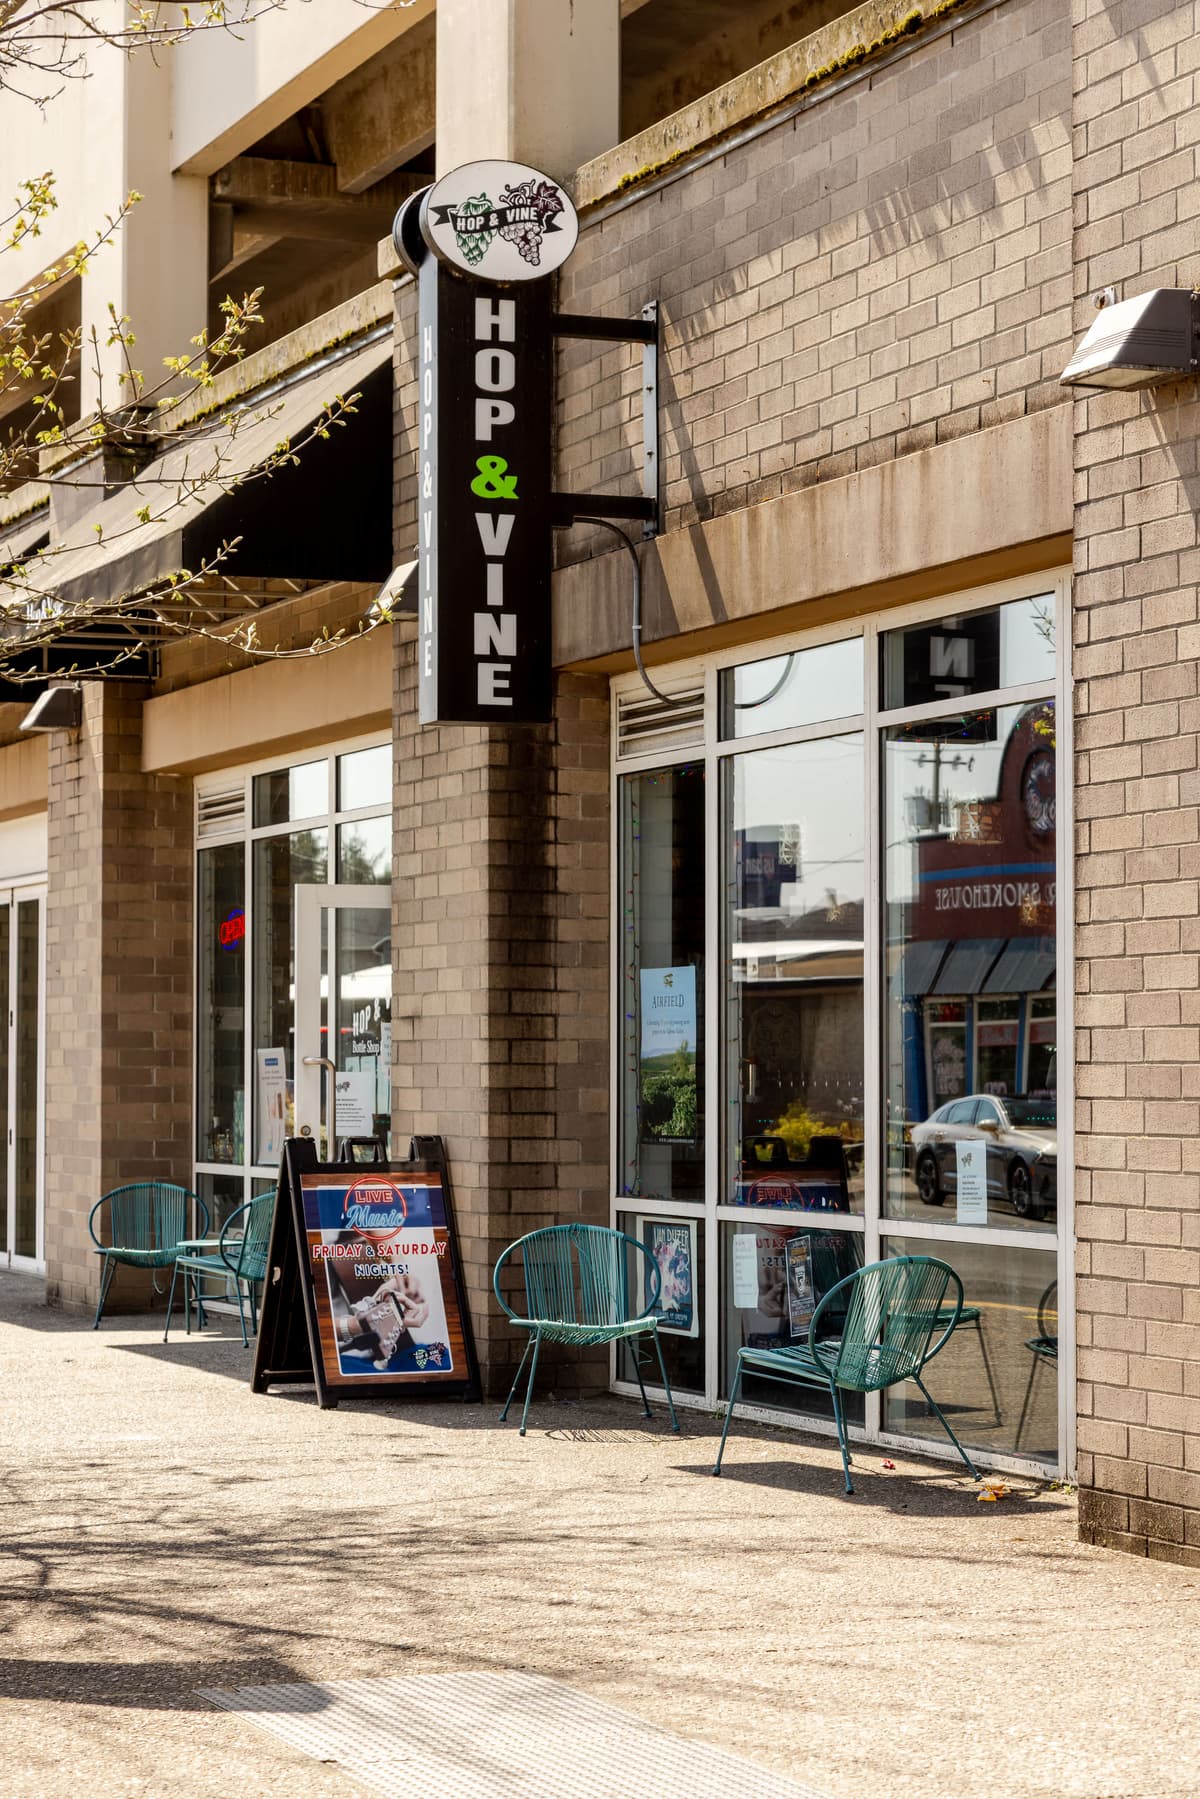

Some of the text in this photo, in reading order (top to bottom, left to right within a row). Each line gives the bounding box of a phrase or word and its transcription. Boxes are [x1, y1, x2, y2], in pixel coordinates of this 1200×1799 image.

[456, 206, 539, 231] HOP & VINE
[423, 325, 432, 677] HOP & VINE
[470, 297, 520, 706] HOP & VINE
[219, 914, 246, 945] OPEN
[651, 993, 686, 1009] AIRFIELD
[352, 997, 381, 1038] HOP &
[366, 1039, 380, 1057] Shop
[355, 1190, 394, 1203] LIVE
[345, 1204, 407, 1229] Music
[312, 1241, 448, 1258] FRIDAY & SATURDAY
[354, 1263, 410, 1277] NIGHTS!
